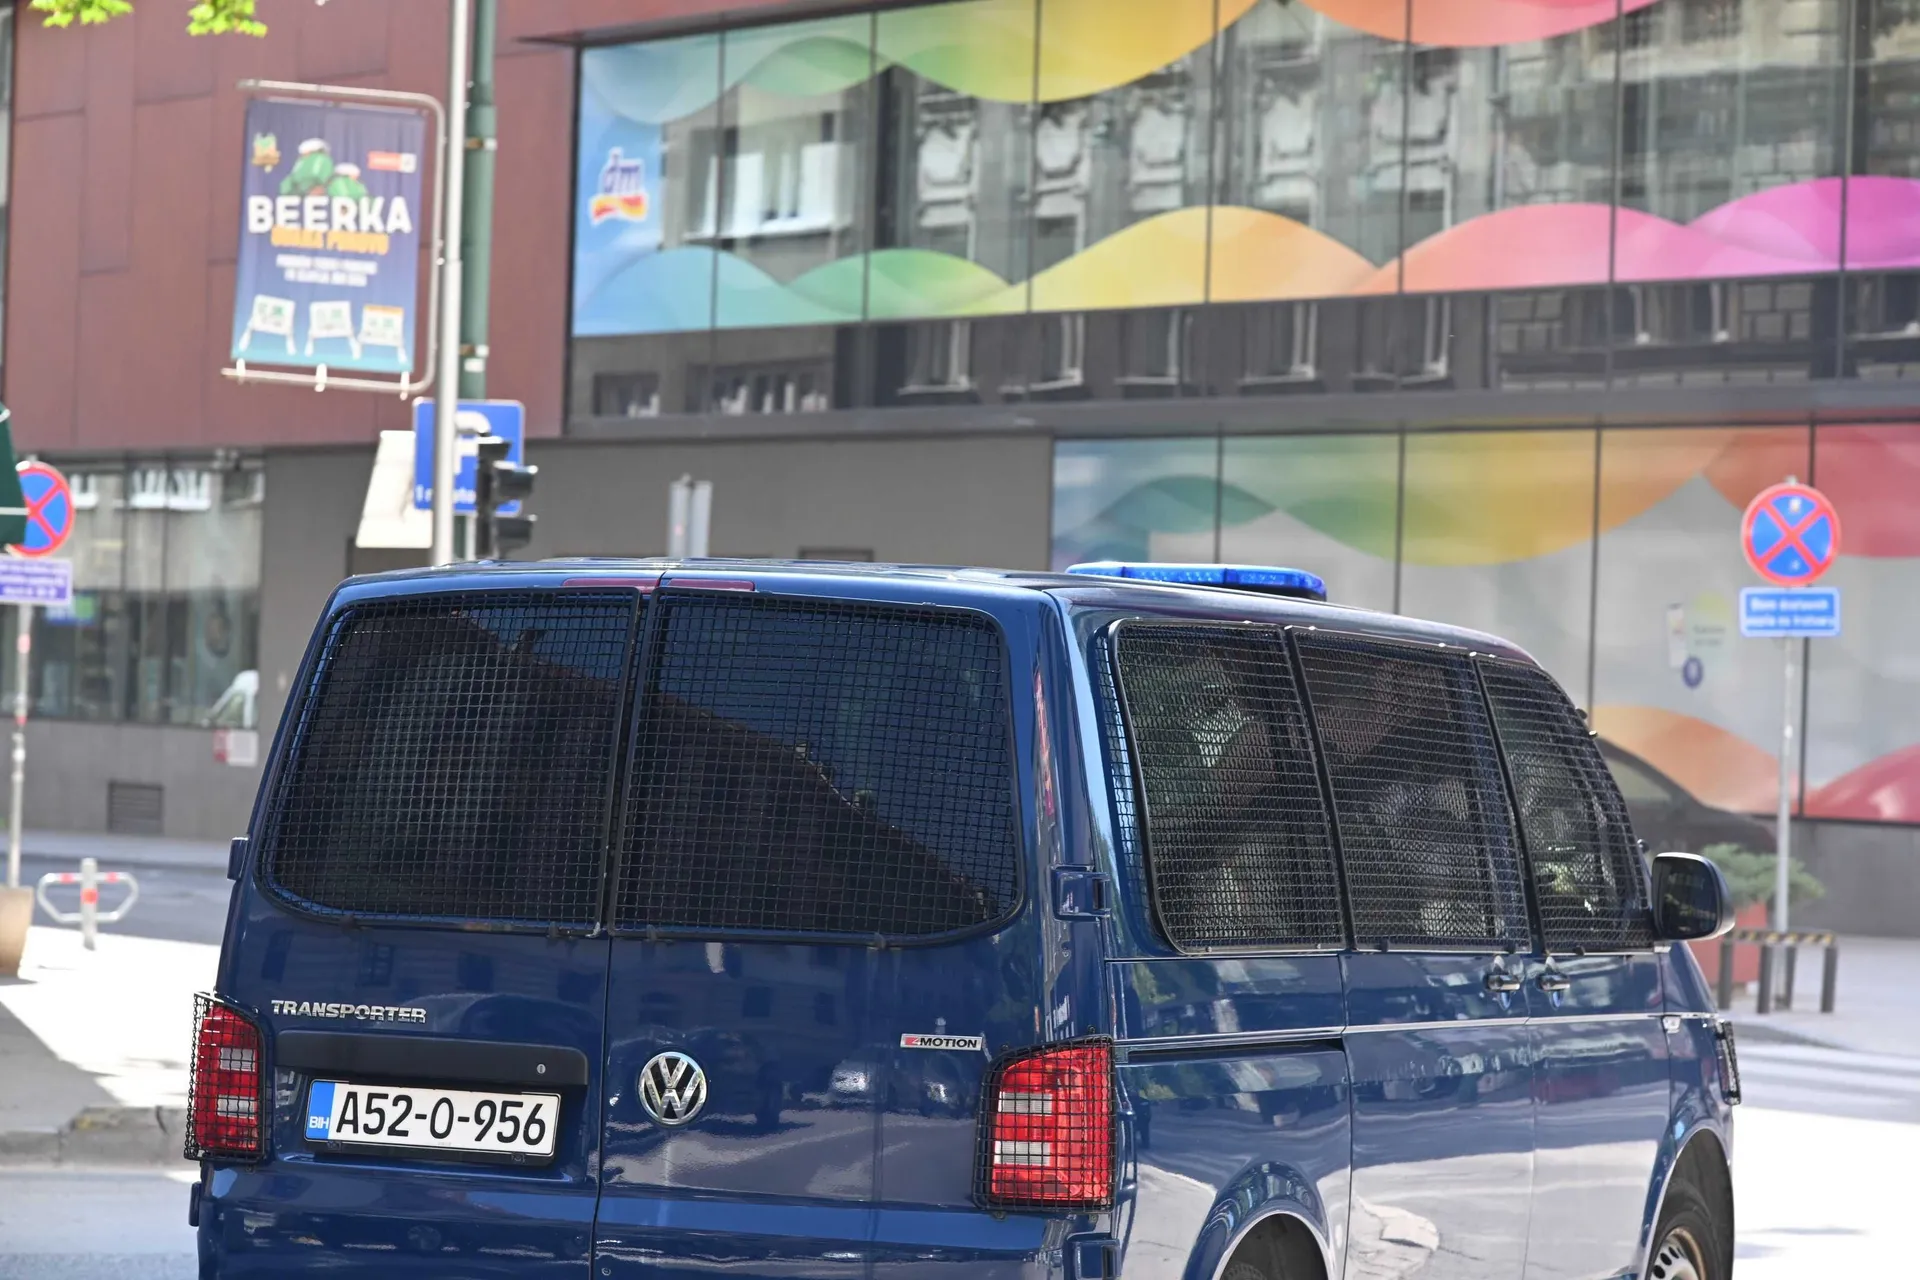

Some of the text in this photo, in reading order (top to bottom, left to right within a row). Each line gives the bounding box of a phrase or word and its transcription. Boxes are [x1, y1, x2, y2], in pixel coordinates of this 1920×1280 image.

[602, 150, 643, 195] dm
[248, 195, 412, 234] BEERKA
[271, 999, 427, 1024] TRANSPORTER
[309, 1115, 330, 1130] BIH
